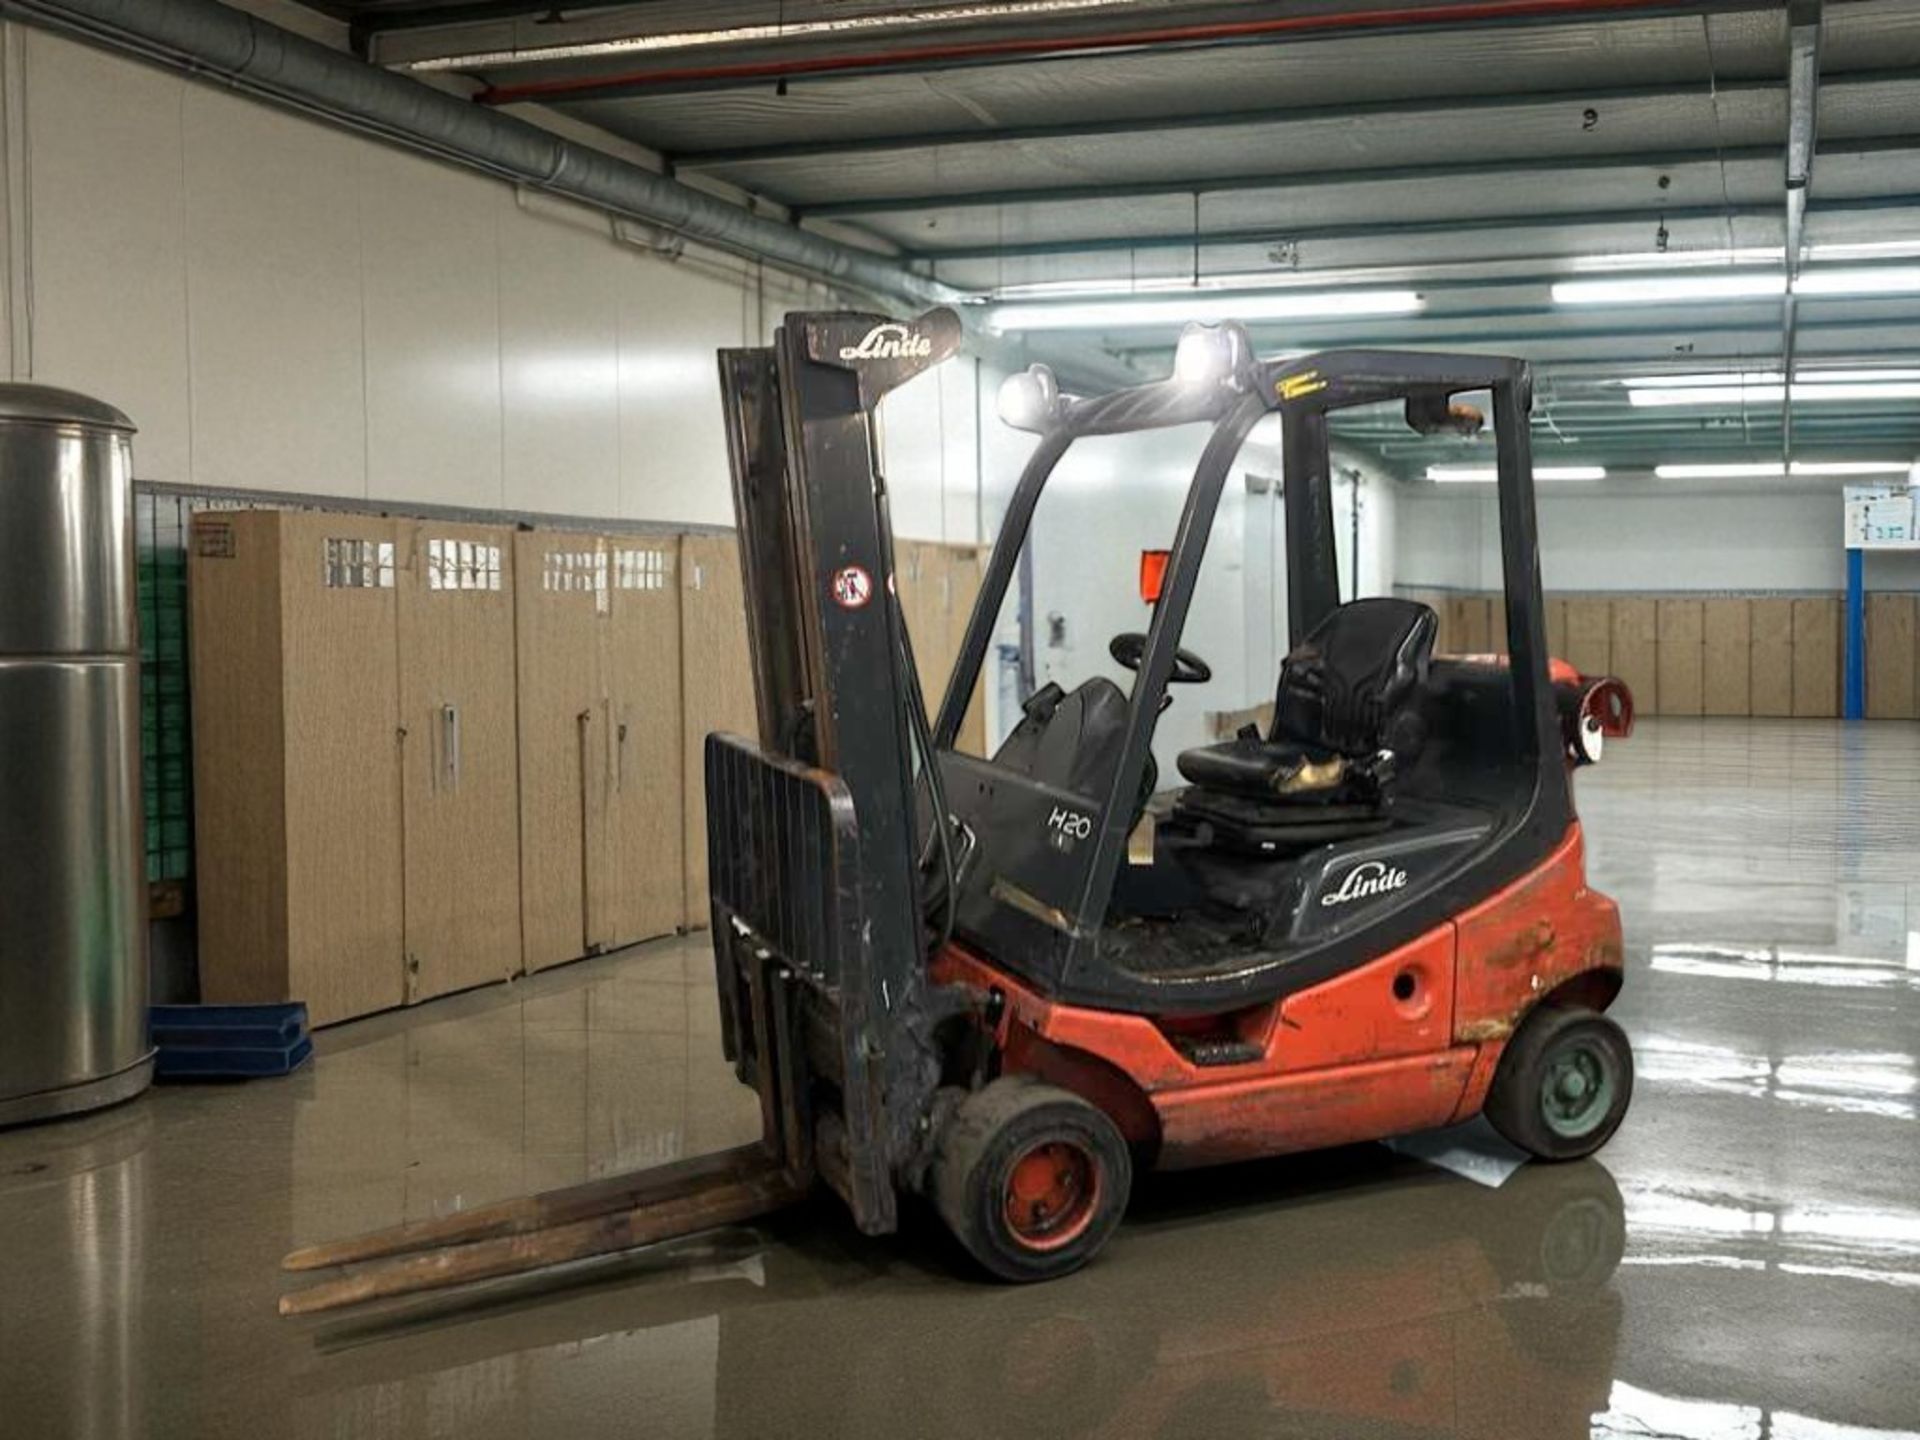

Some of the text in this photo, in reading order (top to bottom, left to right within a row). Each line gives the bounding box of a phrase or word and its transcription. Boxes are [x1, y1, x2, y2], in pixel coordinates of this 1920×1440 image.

[839, 323, 931, 359] Linde
[1047, 805, 1091, 839] H20
[1321, 861, 1407, 906] Linde
